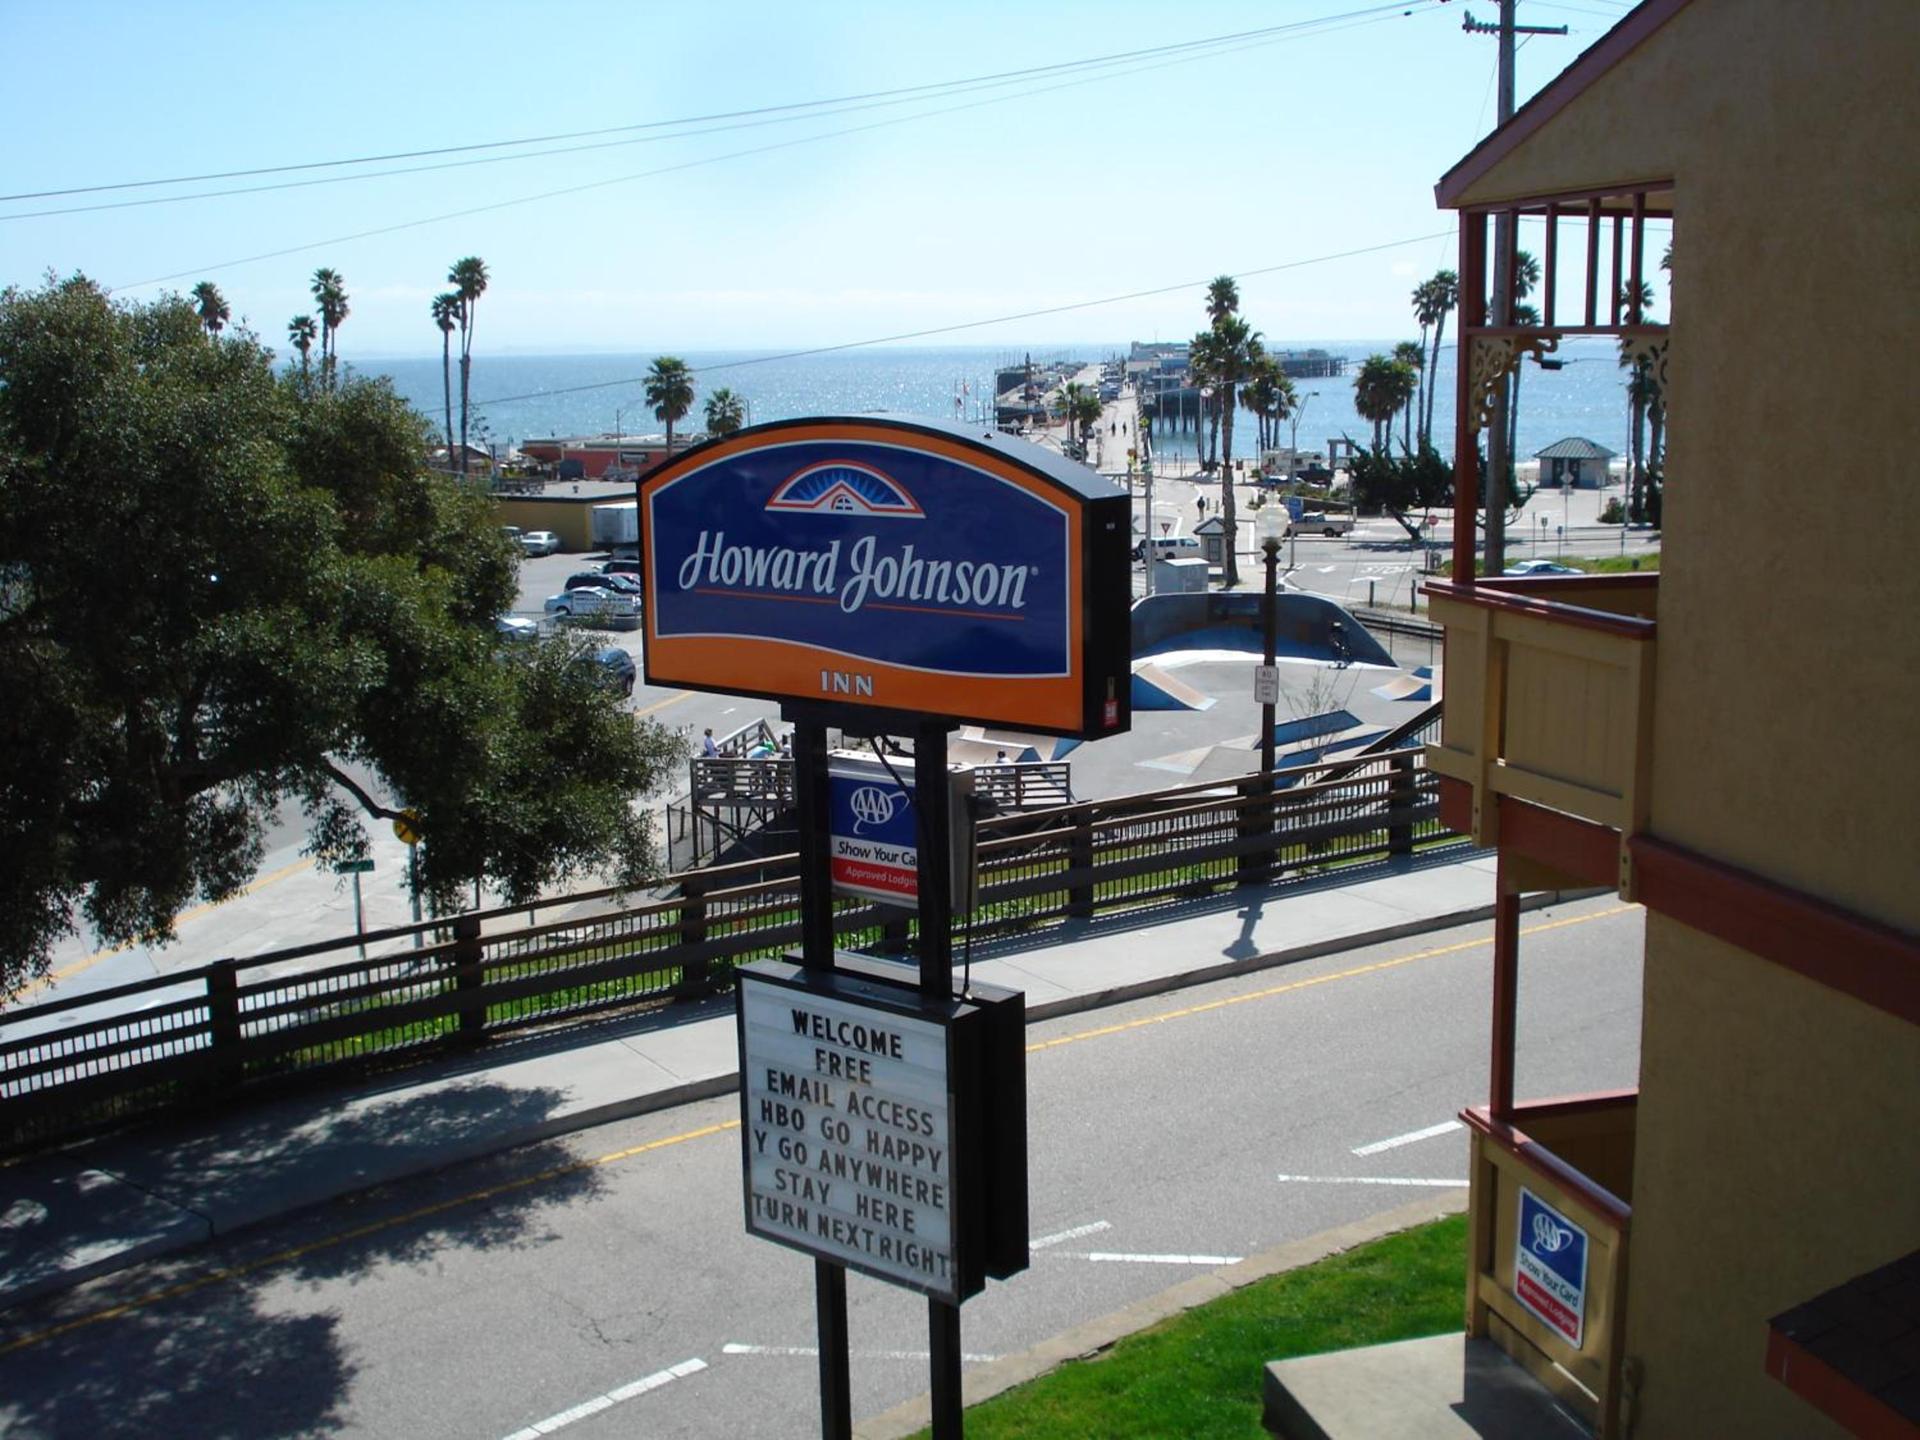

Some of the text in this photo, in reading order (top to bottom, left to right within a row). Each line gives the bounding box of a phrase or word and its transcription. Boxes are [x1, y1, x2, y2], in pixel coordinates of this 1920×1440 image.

[678, 530, 1026, 613] Howard Johnson
[821, 671, 873, 697] INN
[853, 787, 891, 823] AAA
[838, 841, 871, 859] Show
[874, 847, 899, 863] Your
[846, 866, 887, 881] Approved
[791, 1008, 903, 1060] WELCOME
[815, 1048, 872, 1085] FREE
[767, 1068, 934, 1137] EMAIL ACCESS
[761, 1099, 942, 1173] HBO GO HAPPY
[754, 1129, 944, 1209] Y GO ANYWHERE
[775, 1168, 915, 1235] STAY HERE
[753, 1193, 951, 1279] TURN NEXT RIGHT
[1542, 1270, 1558, 1291] Your
[1560, 1284, 1579, 1308] Card
